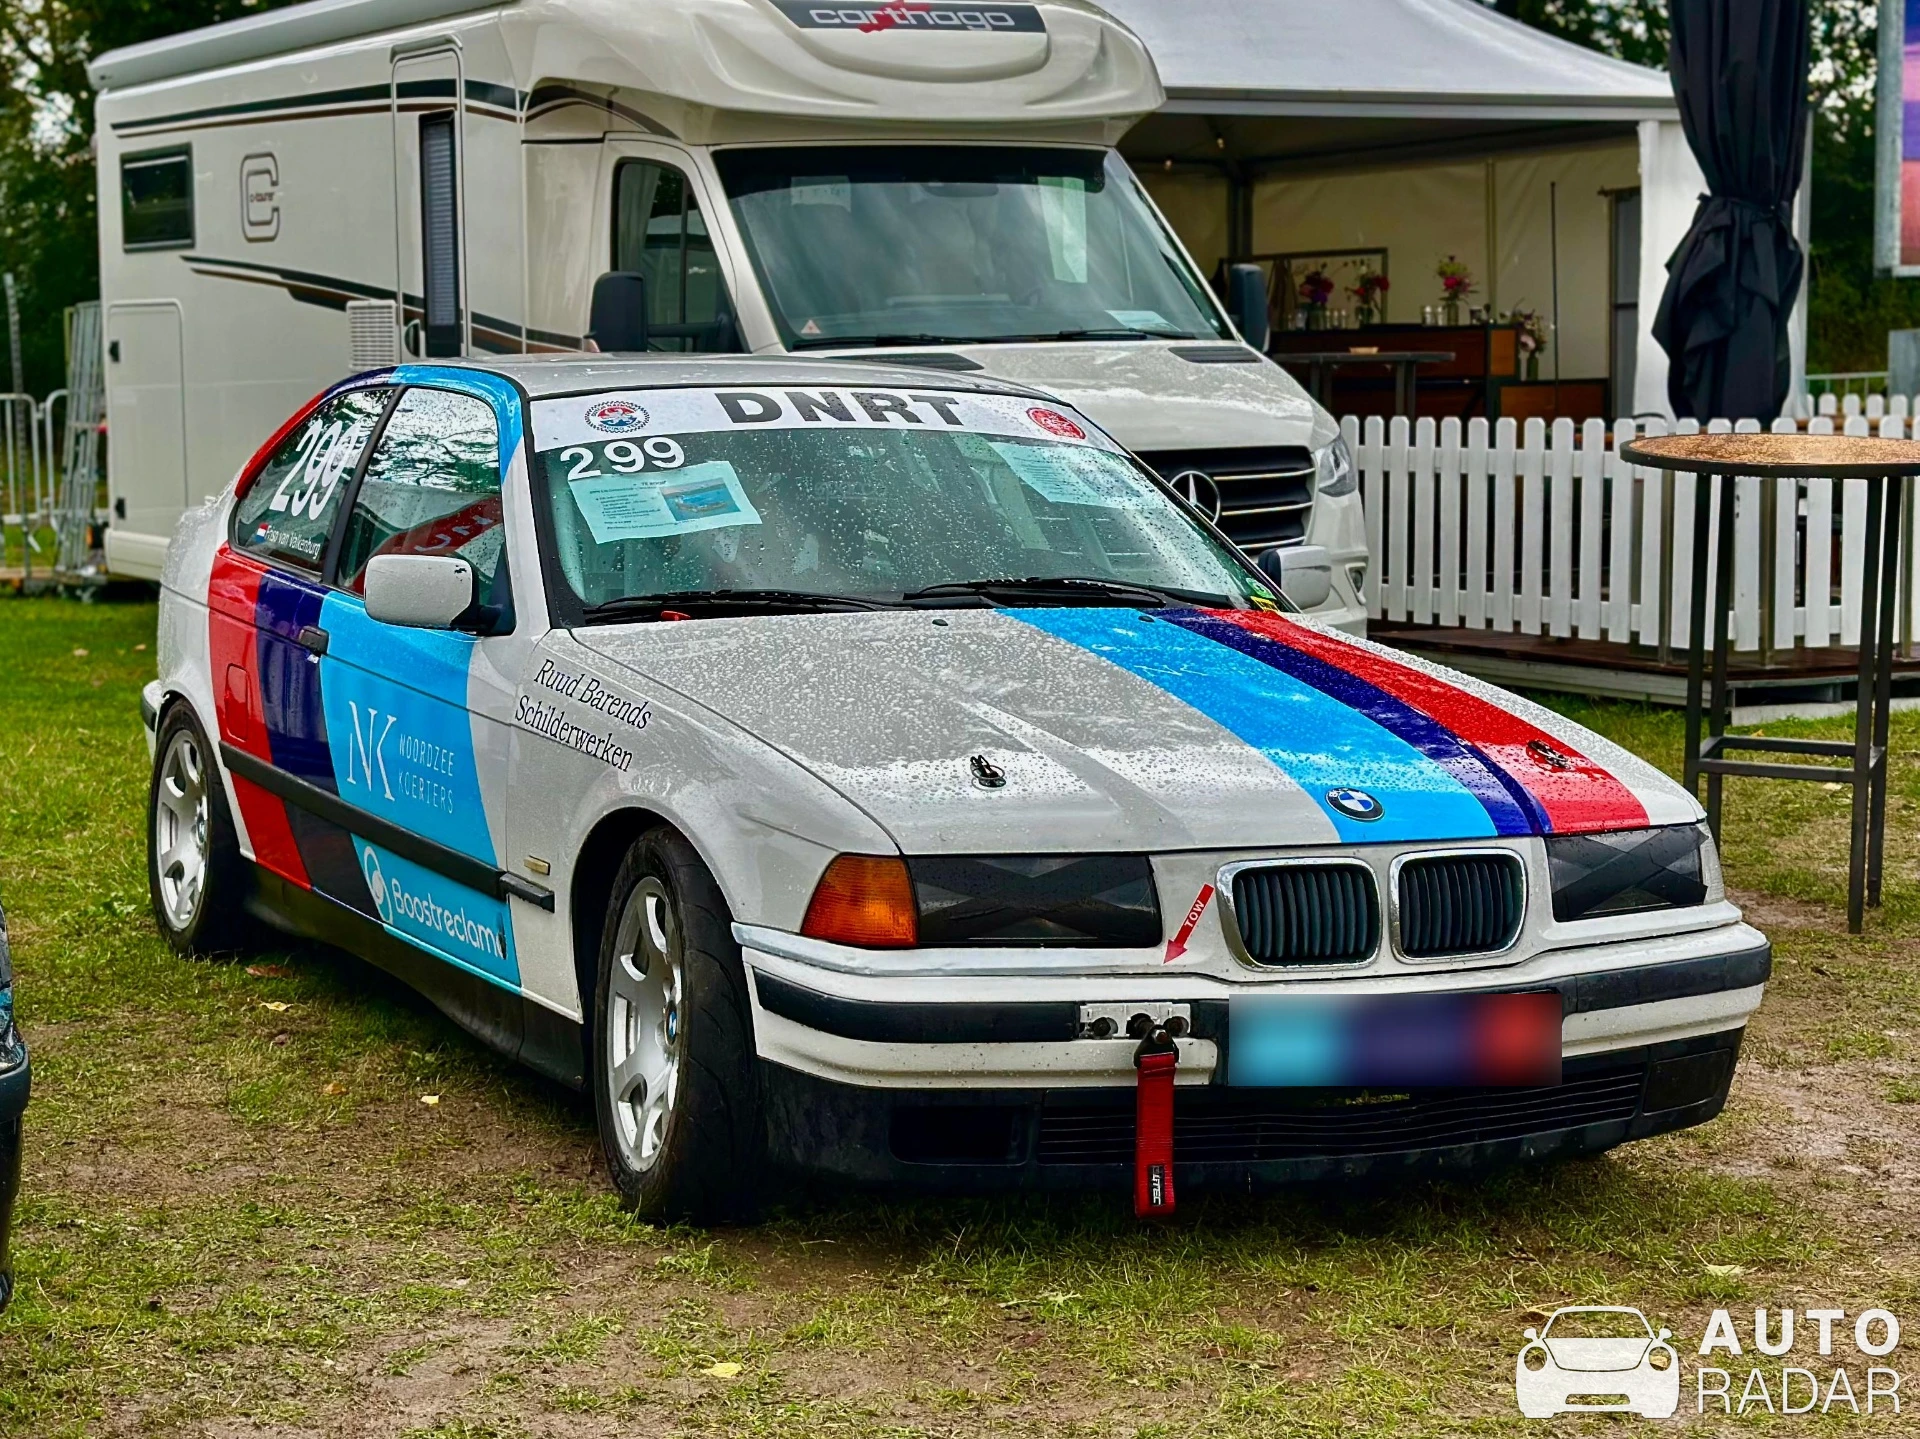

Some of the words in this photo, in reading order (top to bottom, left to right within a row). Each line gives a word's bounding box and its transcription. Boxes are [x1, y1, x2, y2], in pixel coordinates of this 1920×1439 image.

[808, 7, 1016, 31] carthago
[714, 391, 964, 426] DNRT
[268, 418, 363, 521] 299
[560, 436, 685, 482] 299
[533, 658, 586, 699] Ruud
[577, 677, 653, 730] Barends
[398, 733, 456, 777] NOORDZEE
[514, 694, 634, 773] Schilderwerken
[397, 769, 454, 815] KOERIERS
[1183, 899, 1206, 928] TOW
